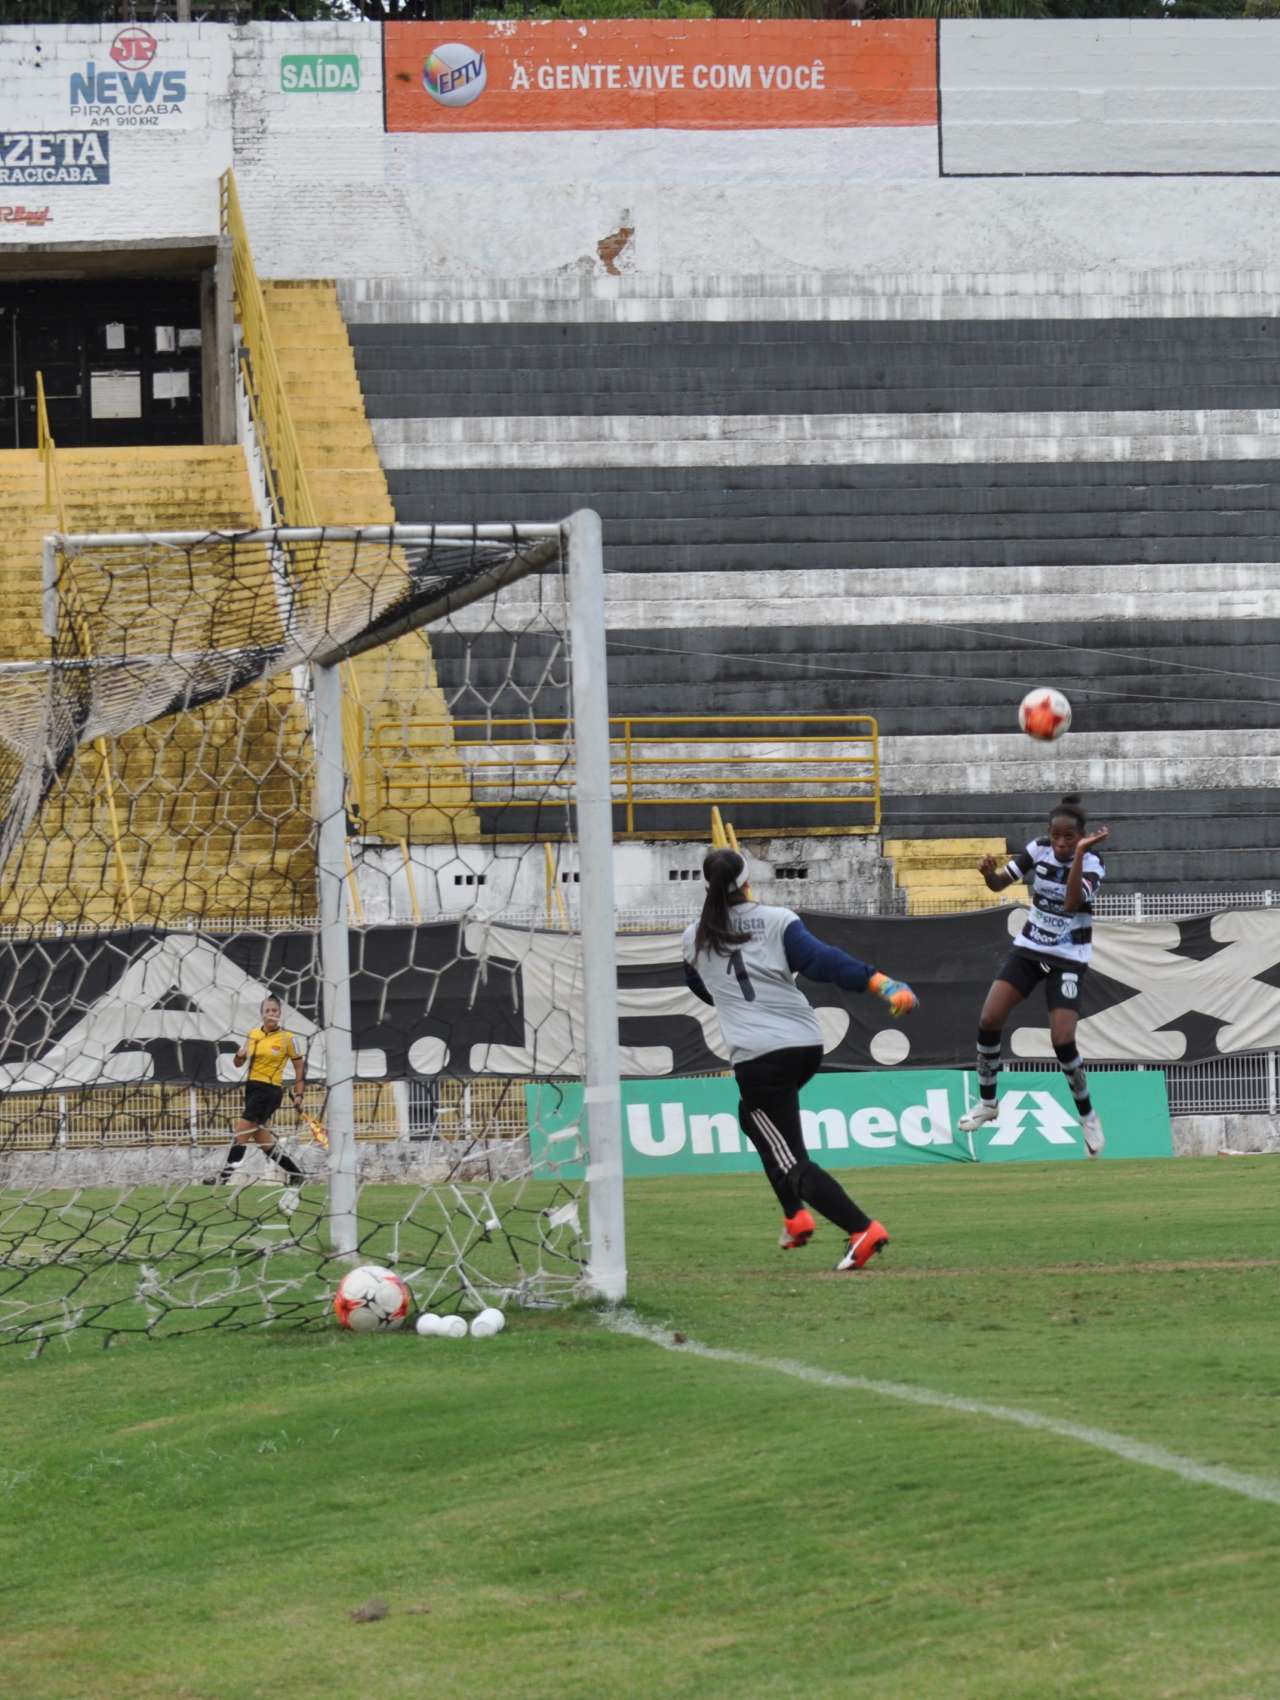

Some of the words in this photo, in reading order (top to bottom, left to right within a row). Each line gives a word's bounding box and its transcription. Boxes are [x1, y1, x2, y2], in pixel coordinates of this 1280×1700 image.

[110, 36, 157, 63] JP
[69, 62, 187, 105] NEWS
[282, 59, 357, 89] SAÍDA
[438, 49, 486, 96] EPTV
[511, 64, 532, 90] A
[537, 64, 622, 90] GENTE
[629, 64, 685, 90] VIVE
[692, 64, 751, 89] COM
[759, 59, 826, 90] VOCÊ
[70, 104, 183, 117] PIRACICABA
[90, 117, 109, 127] AM
[117, 116, 137, 127] 910
[139, 116, 159, 126] KHZ
[0, 132, 108, 166] ZETA
[626, 1088, 953, 1157] Unmed
